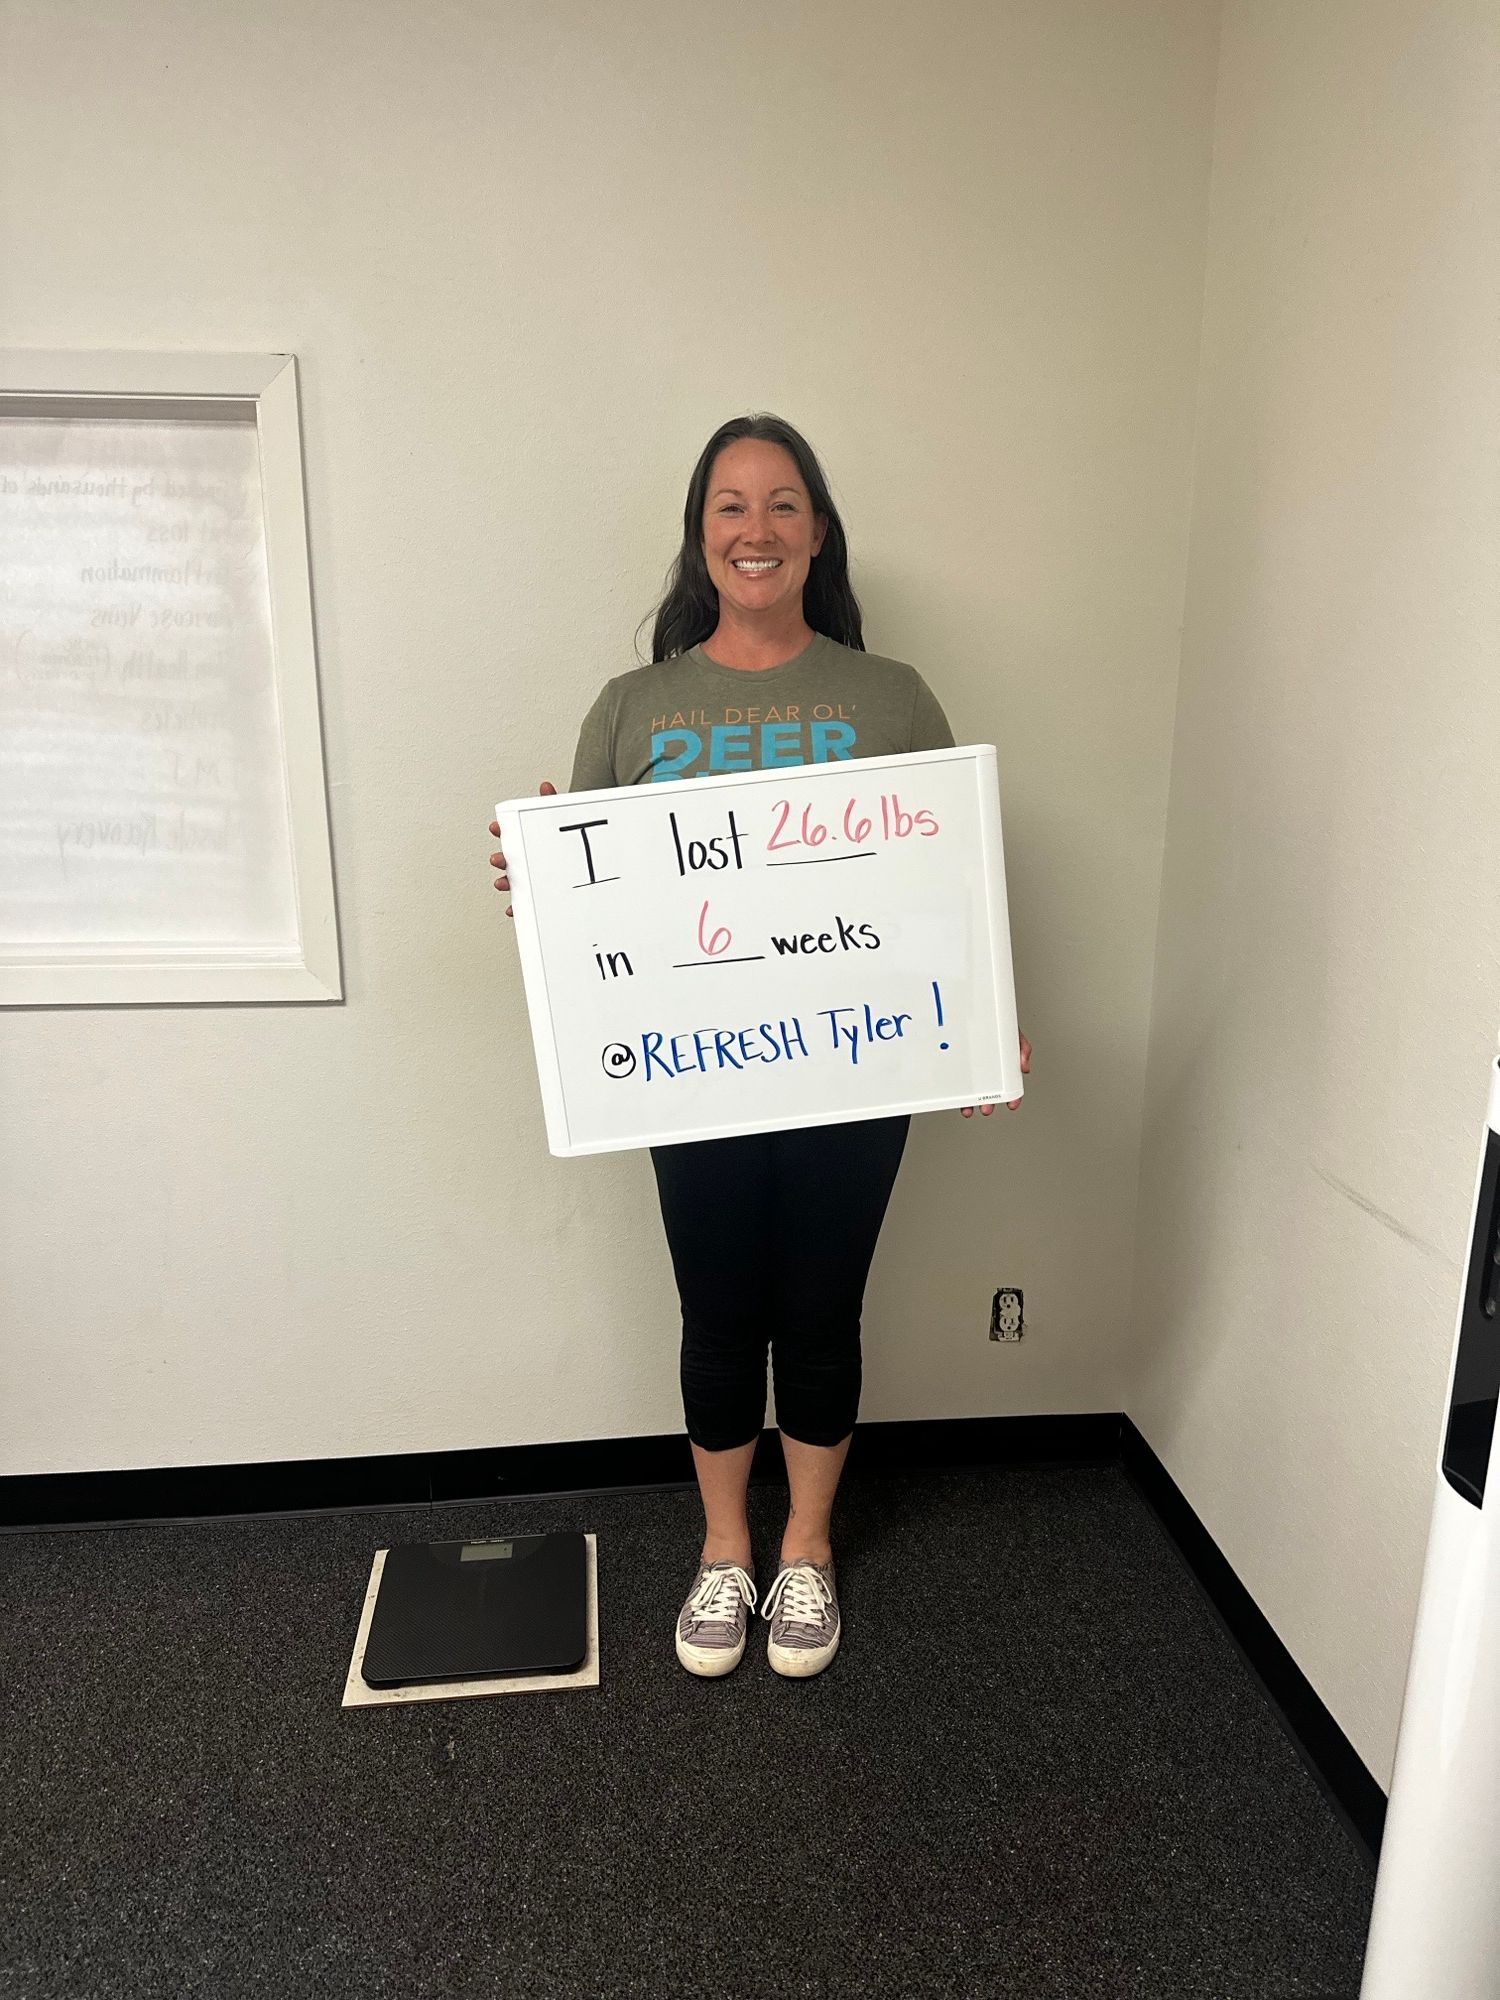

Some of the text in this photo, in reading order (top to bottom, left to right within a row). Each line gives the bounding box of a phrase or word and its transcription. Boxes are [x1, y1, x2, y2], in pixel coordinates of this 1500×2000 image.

[651, 709, 712, 732] HAIL
[725, 705, 800, 724] DEAR
[651, 720, 857, 773] DEER
[559, 819, 621, 888] I
[669, 811, 749, 876] lost
[592, 900, 882, 981] in 6 weeks
[816, 1003, 912, 1065] Tyler
